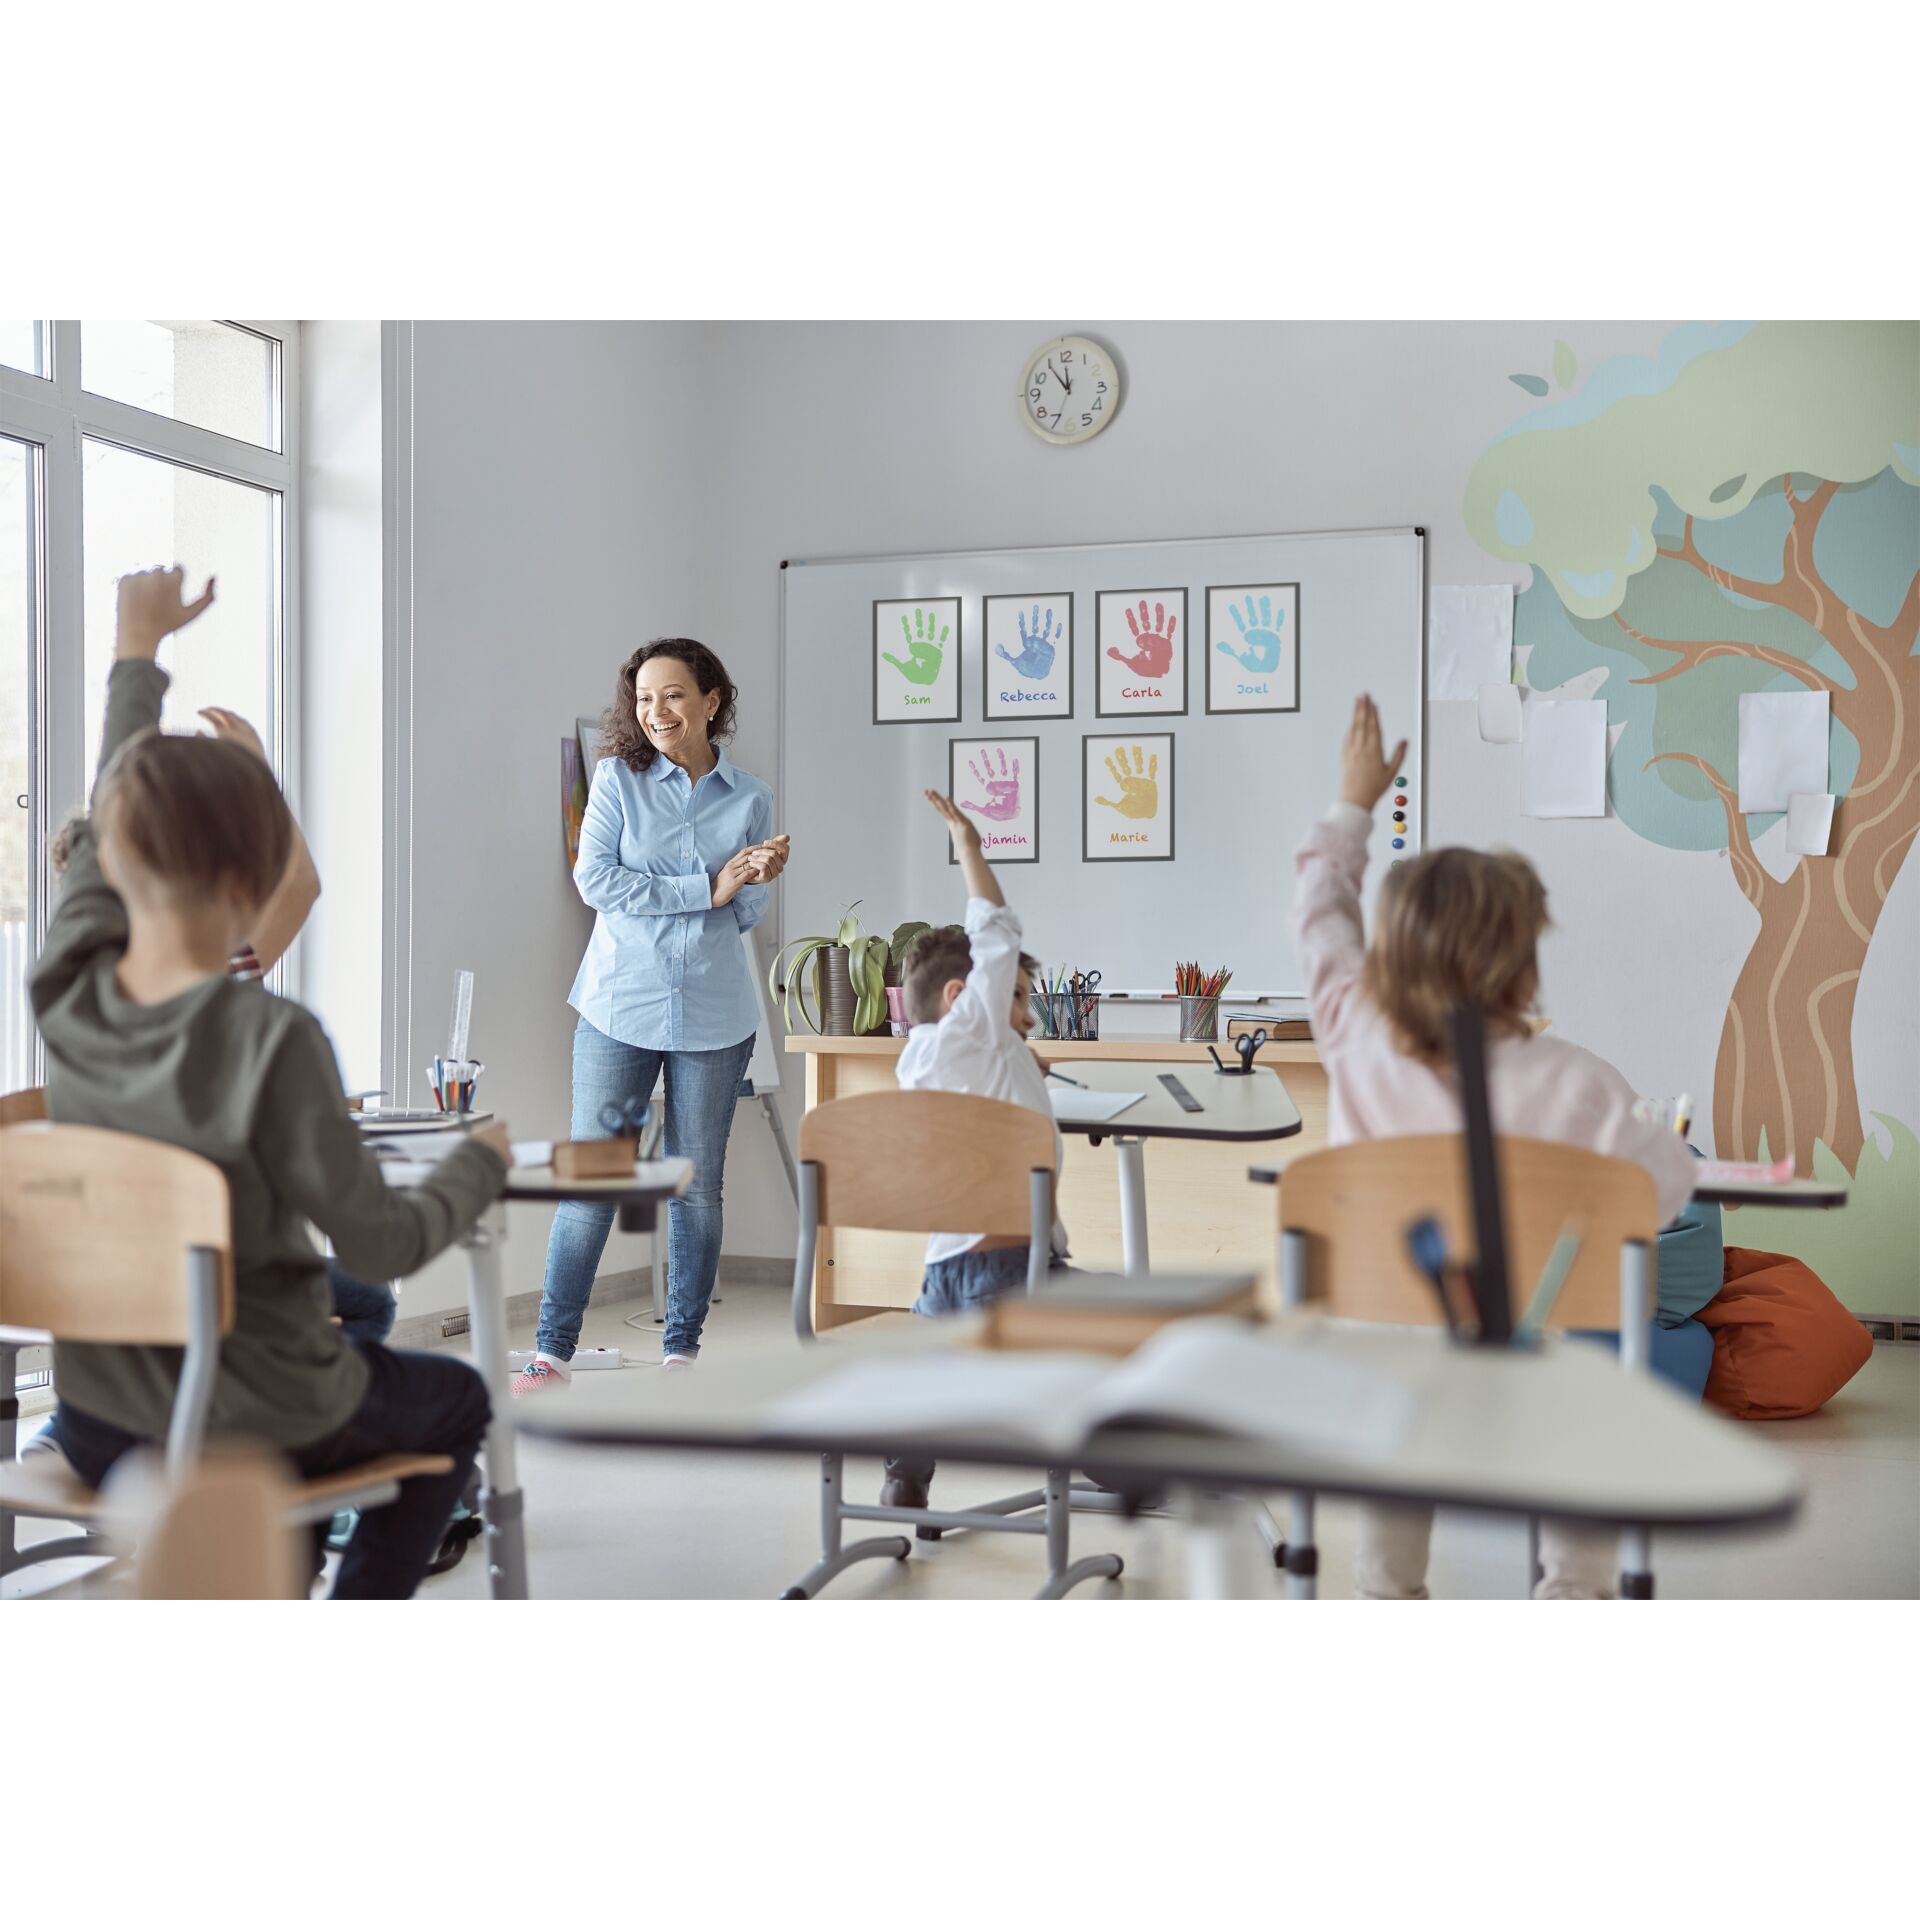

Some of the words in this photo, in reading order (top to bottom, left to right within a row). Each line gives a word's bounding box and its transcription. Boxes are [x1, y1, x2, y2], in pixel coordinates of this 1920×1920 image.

[1060, 350, 1072, 363] 12
[1083, 353, 1086, 365] 1
[1035, 372, 1047, 385] 10
[1096, 381, 1108, 394] 3
[1030, 388, 1041, 403] 9
[1091, 397, 1102, 411] 4
[1036, 406, 1048, 419] 8
[1050, 413, 1062, 430] 7
[1082, 413, 1093, 427] 5
[1121, 687, 1162, 699] Carla
[1237, 683, 1269, 695] Joel
[904, 694, 931, 706] Sam
[1000, 689, 1057, 703] Rebecca
[1109, 832, 1149, 844] Marie
